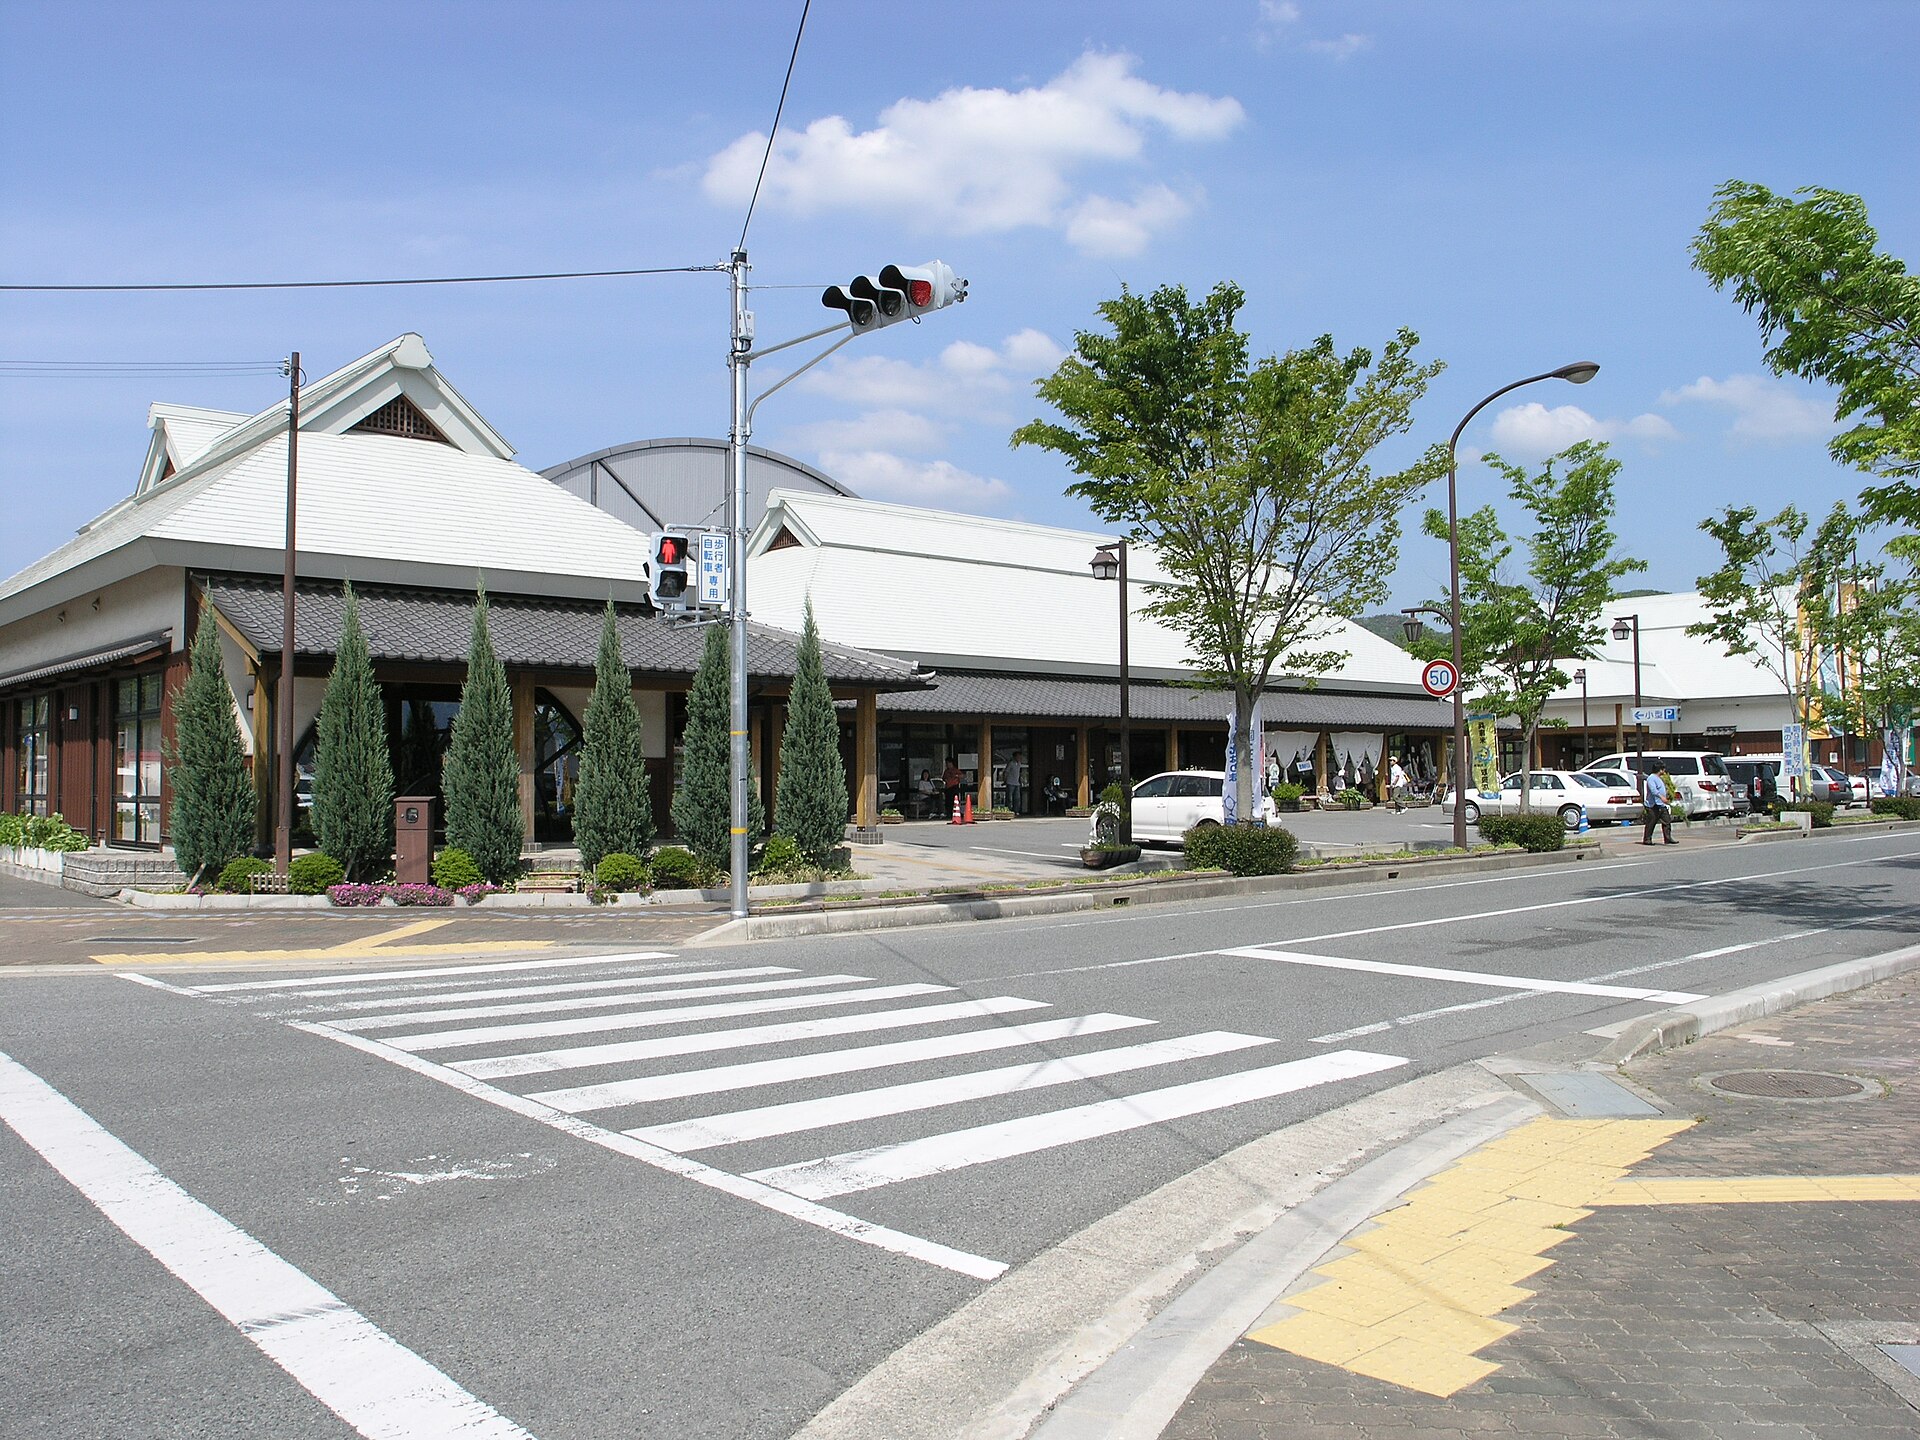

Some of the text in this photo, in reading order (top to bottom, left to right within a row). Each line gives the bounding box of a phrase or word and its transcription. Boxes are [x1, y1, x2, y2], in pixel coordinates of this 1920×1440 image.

[703, 538, 713, 572] 自転車
[714, 539, 724, 573] 歩行者
[708, 575, 718, 599] 専用
[1430, 670, 1449, 685] 50
[1645, 709, 1674, 719] 小型 P
